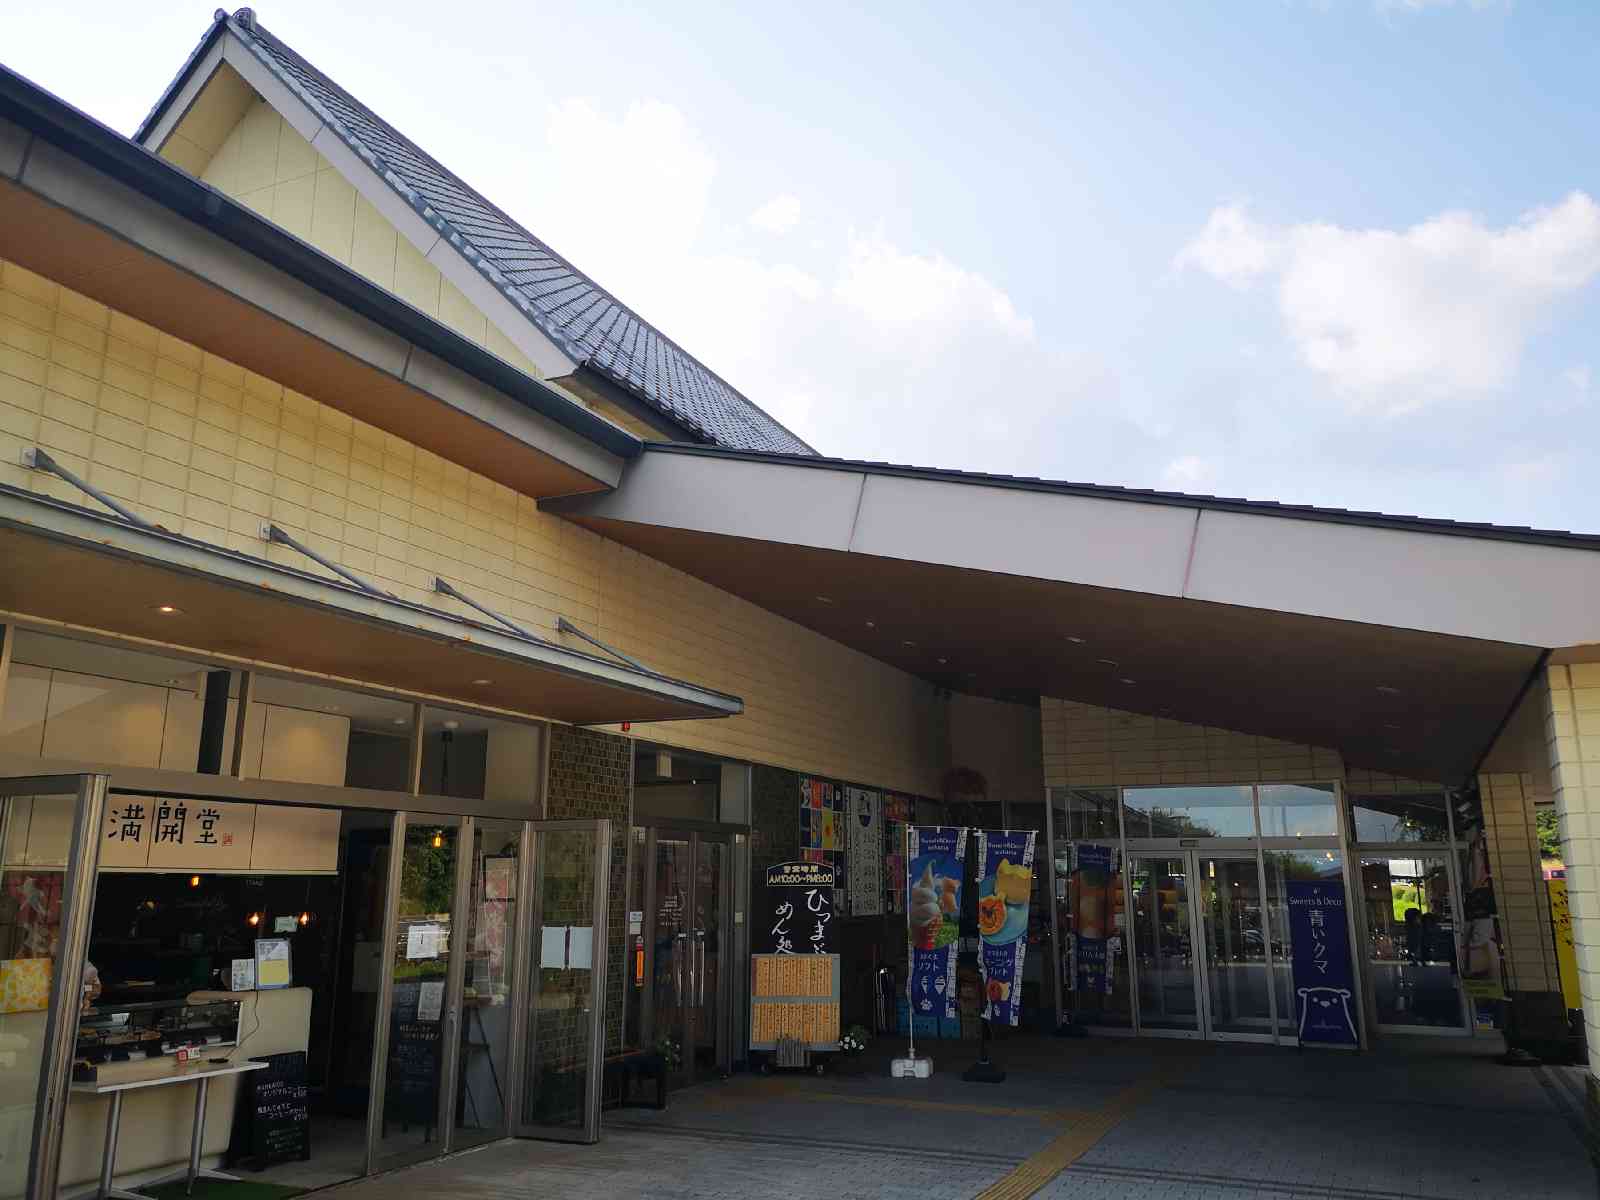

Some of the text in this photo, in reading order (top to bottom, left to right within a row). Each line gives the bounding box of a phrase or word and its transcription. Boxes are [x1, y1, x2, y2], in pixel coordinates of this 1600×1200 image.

[107, 800, 221, 845] 満開堂
[1309, 908, 1329, 975] 青いクマ
